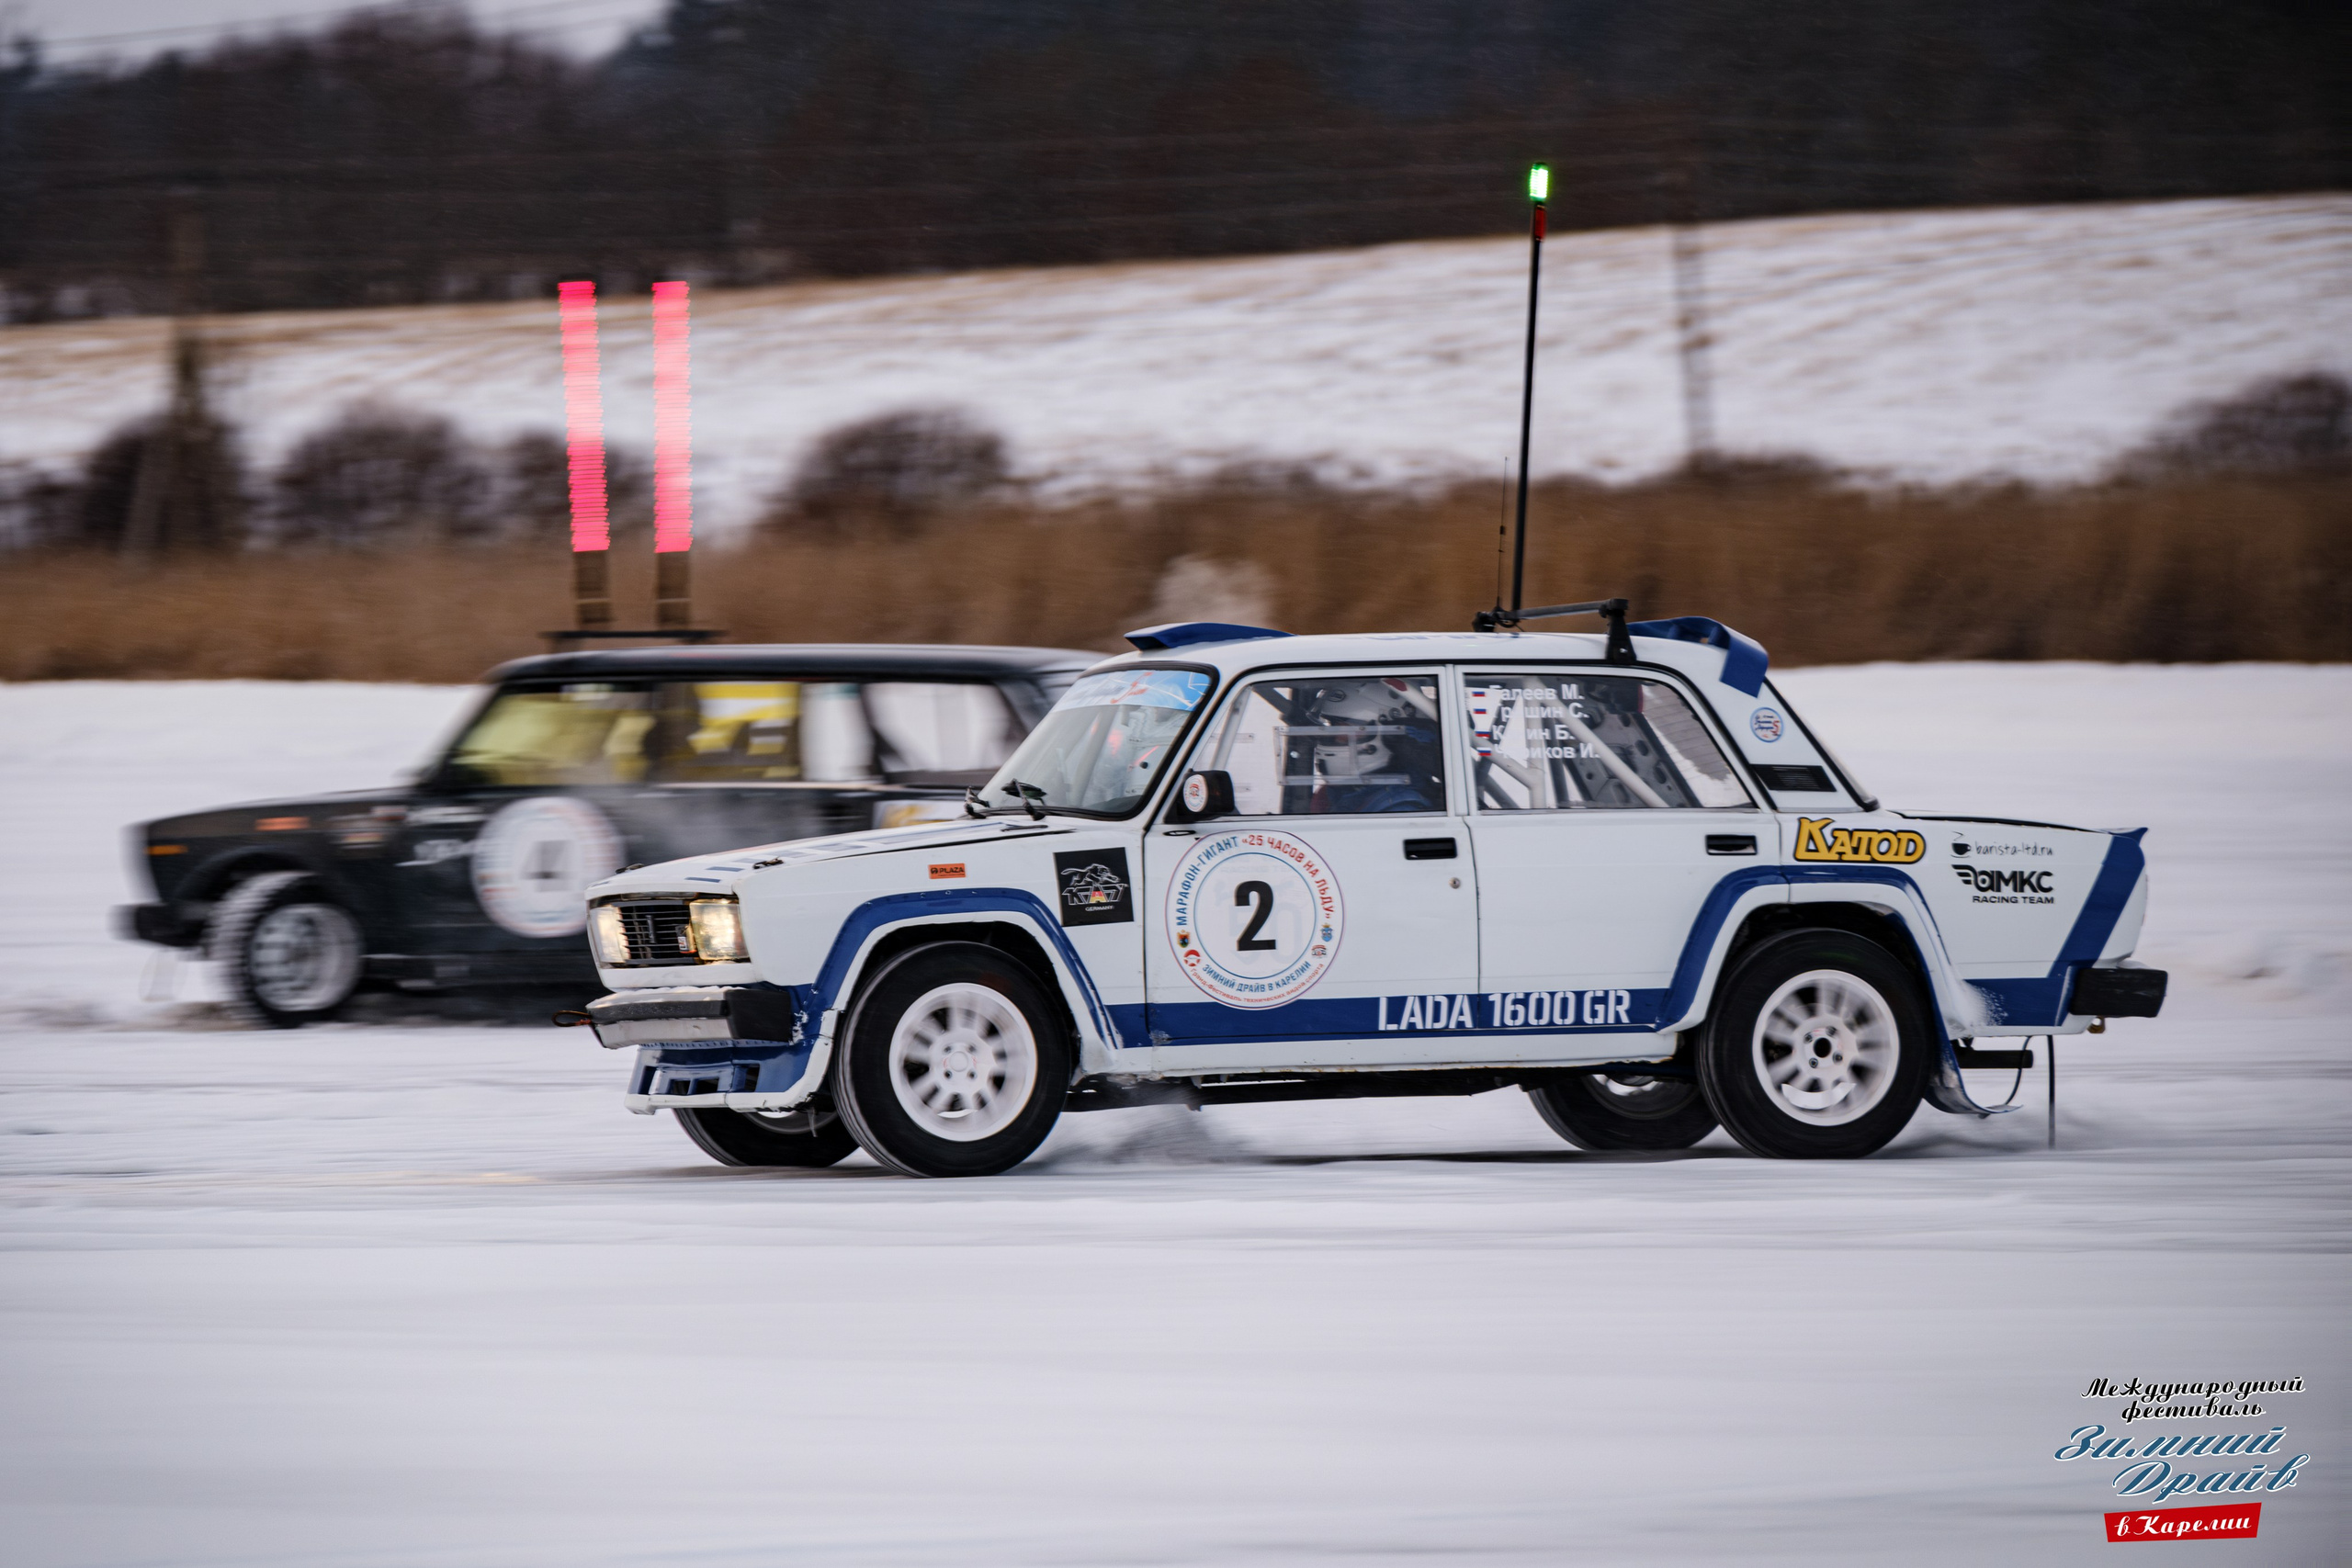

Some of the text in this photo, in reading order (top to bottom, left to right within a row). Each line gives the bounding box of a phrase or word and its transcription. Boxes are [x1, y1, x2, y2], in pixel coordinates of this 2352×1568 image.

[1561, 683, 1585, 700] М.
[1494, 702, 1589, 722] ршин С.
[1492, 724, 1576, 740] Кин Б.
[1579, 742, 1600, 758] И.
[1793, 817, 1927, 864] KATOD
[1974, 840, 2054, 856] barista-ltd.ru
[939, 866, 966, 874] PLAZA
[1176, 834, 1335, 926] МАРАФОН-ГИГАНТ «25 ЧАСОВ НА ЛЬДУ»
[1085, 904, 1114, 912] GERMANY
[1972, 895, 2055, 905] RACING TEAM
[1234, 880, 1276, 952] 2
[1202, 960, 1311, 993] ЗИМНИЙ ДРАЙВ В КАРЕЛИИ
[1378, 989, 1631, 1031] LADA 1600 GR
